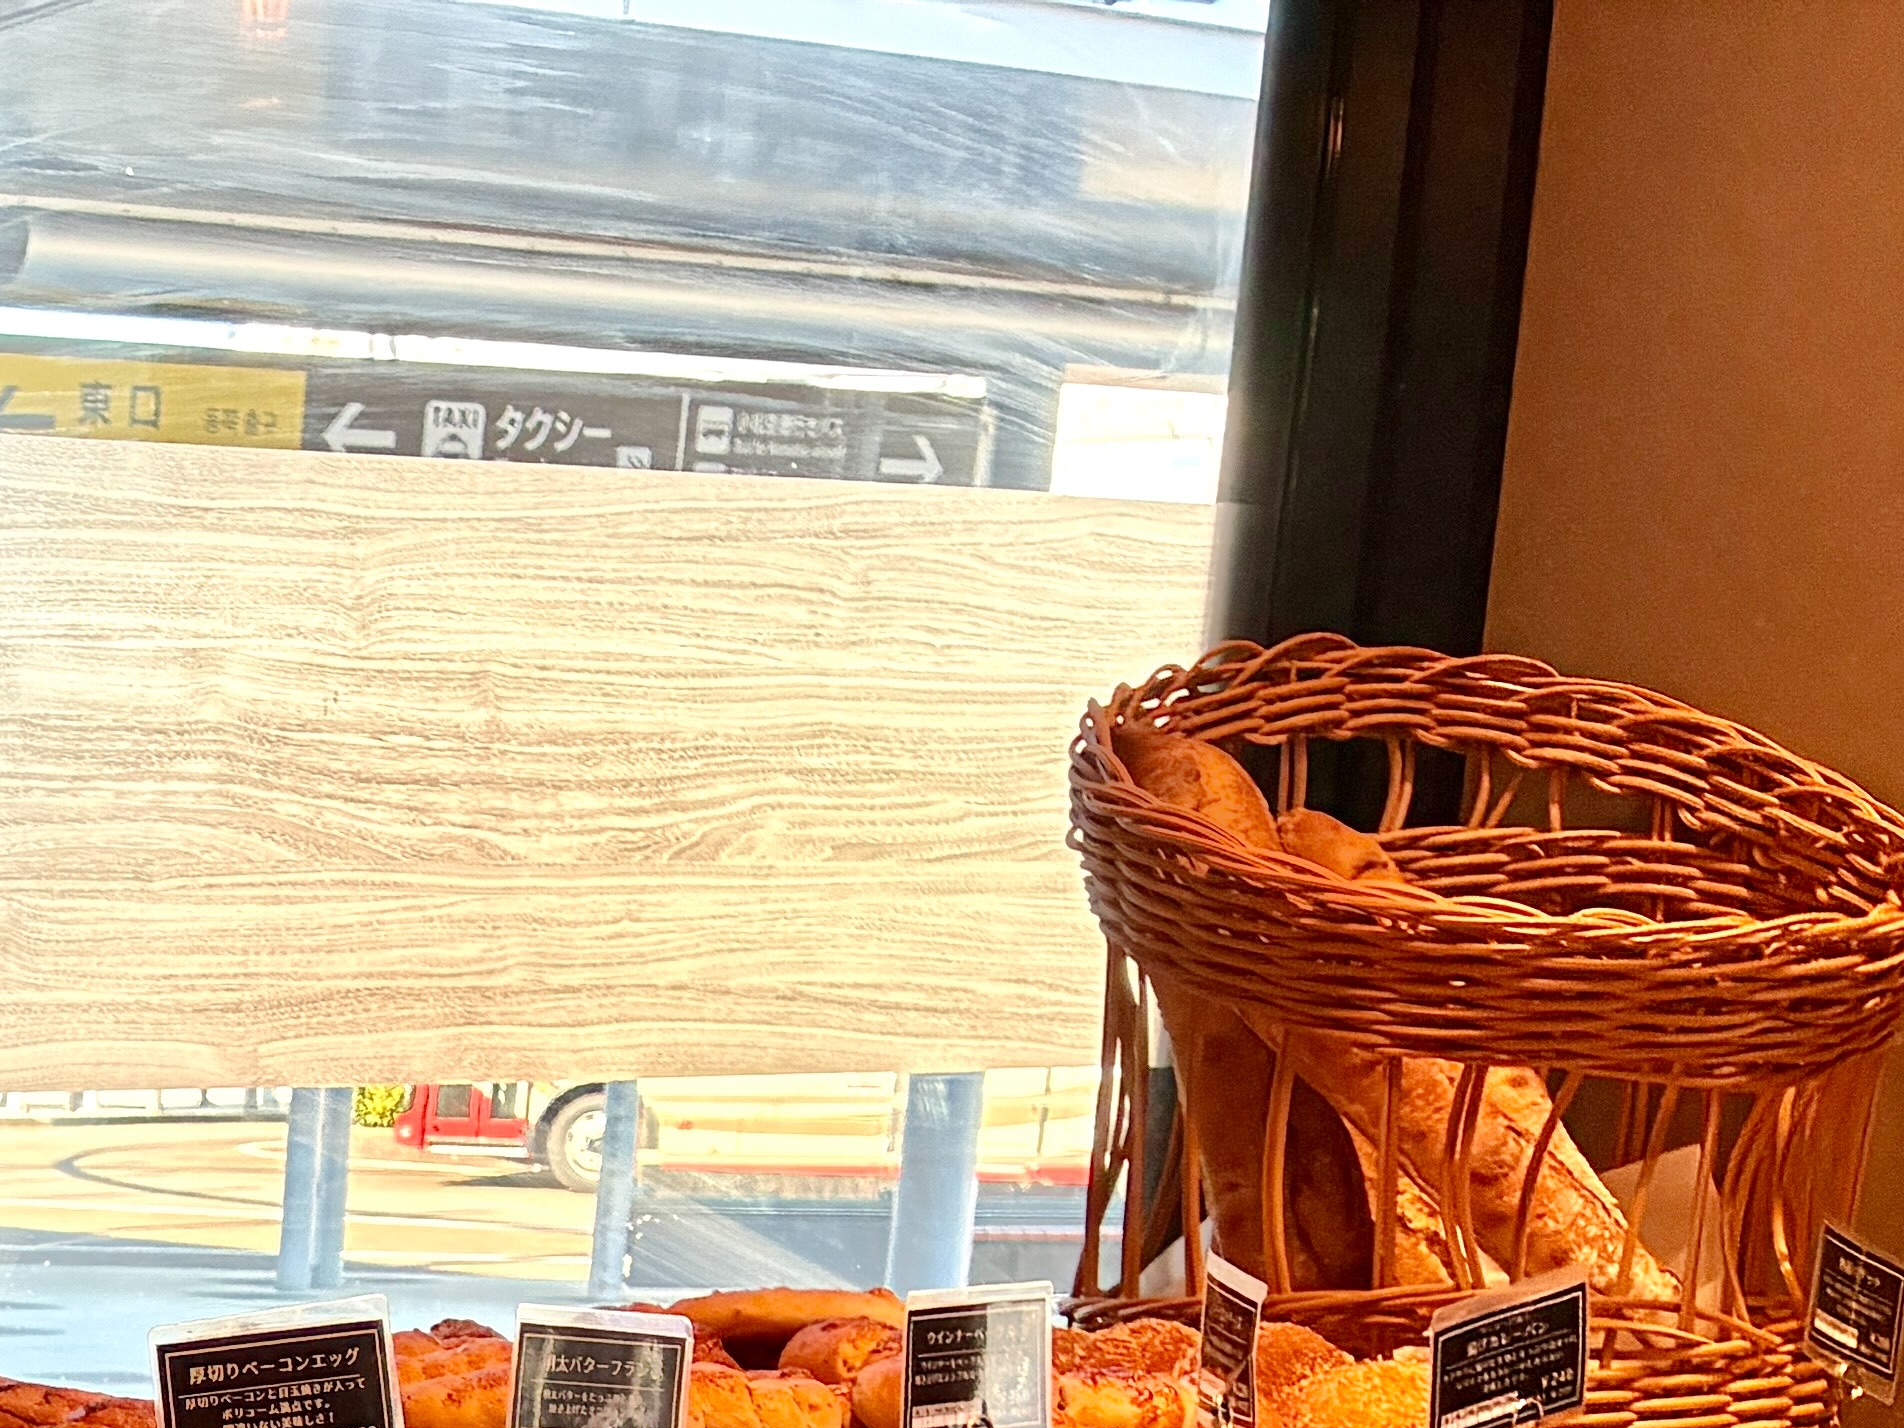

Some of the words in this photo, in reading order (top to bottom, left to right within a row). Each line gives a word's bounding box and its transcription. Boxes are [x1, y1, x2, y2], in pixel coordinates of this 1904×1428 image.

[77, 381, 161, 430] 東口
[433, 406, 479, 429] TAXI
[496, 404, 611, 452] タクシー
[189, 1347, 359, 1385] 厚切りベーコンエッグ
